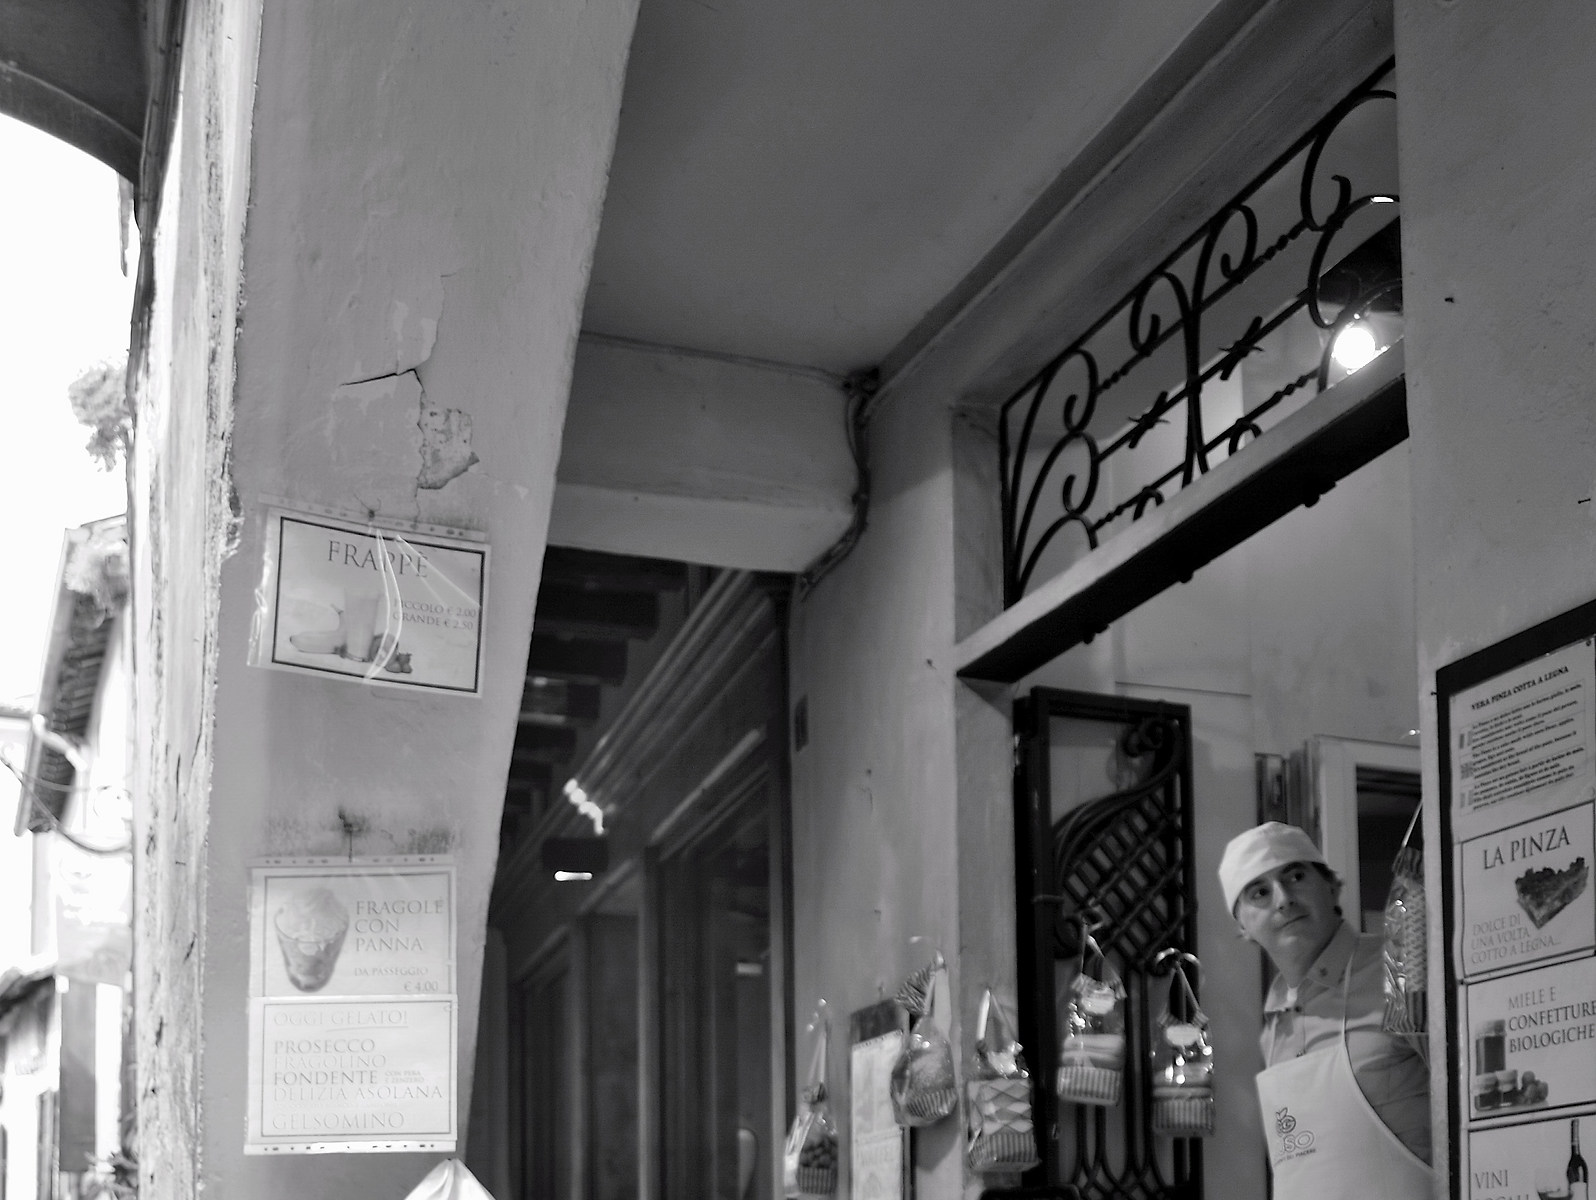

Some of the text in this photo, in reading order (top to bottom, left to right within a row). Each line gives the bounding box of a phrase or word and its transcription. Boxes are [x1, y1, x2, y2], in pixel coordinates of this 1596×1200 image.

[1482, 824, 1571, 871] LA PINZA
[356, 898, 445, 916] FRAGOLE
[354, 918, 400, 934] CON
[1472, 915, 1506, 937] DOLCE
[356, 936, 424, 953] PANNA
[354, 967, 369, 977] DA
[1508, 985, 1557, 1011] MIELE E
[273, 1009, 325, 1026] OGGI
[1508, 999, 1596, 1032] CONFETTURE
[273, 1038, 377, 1055] PROSECCO
[1509, 1022, 1596, 1054] BIOLOGICHE
[274, 1054, 387, 1070] FRAGOLINO
[273, 1070, 379, 1087] FONDENTE
[273, 1085, 444, 1102] DELIZIA ASOLANA
[272, 1111, 405, 1130] GELSOMINO
[1474, 1169, 1509, 1189] VINI
